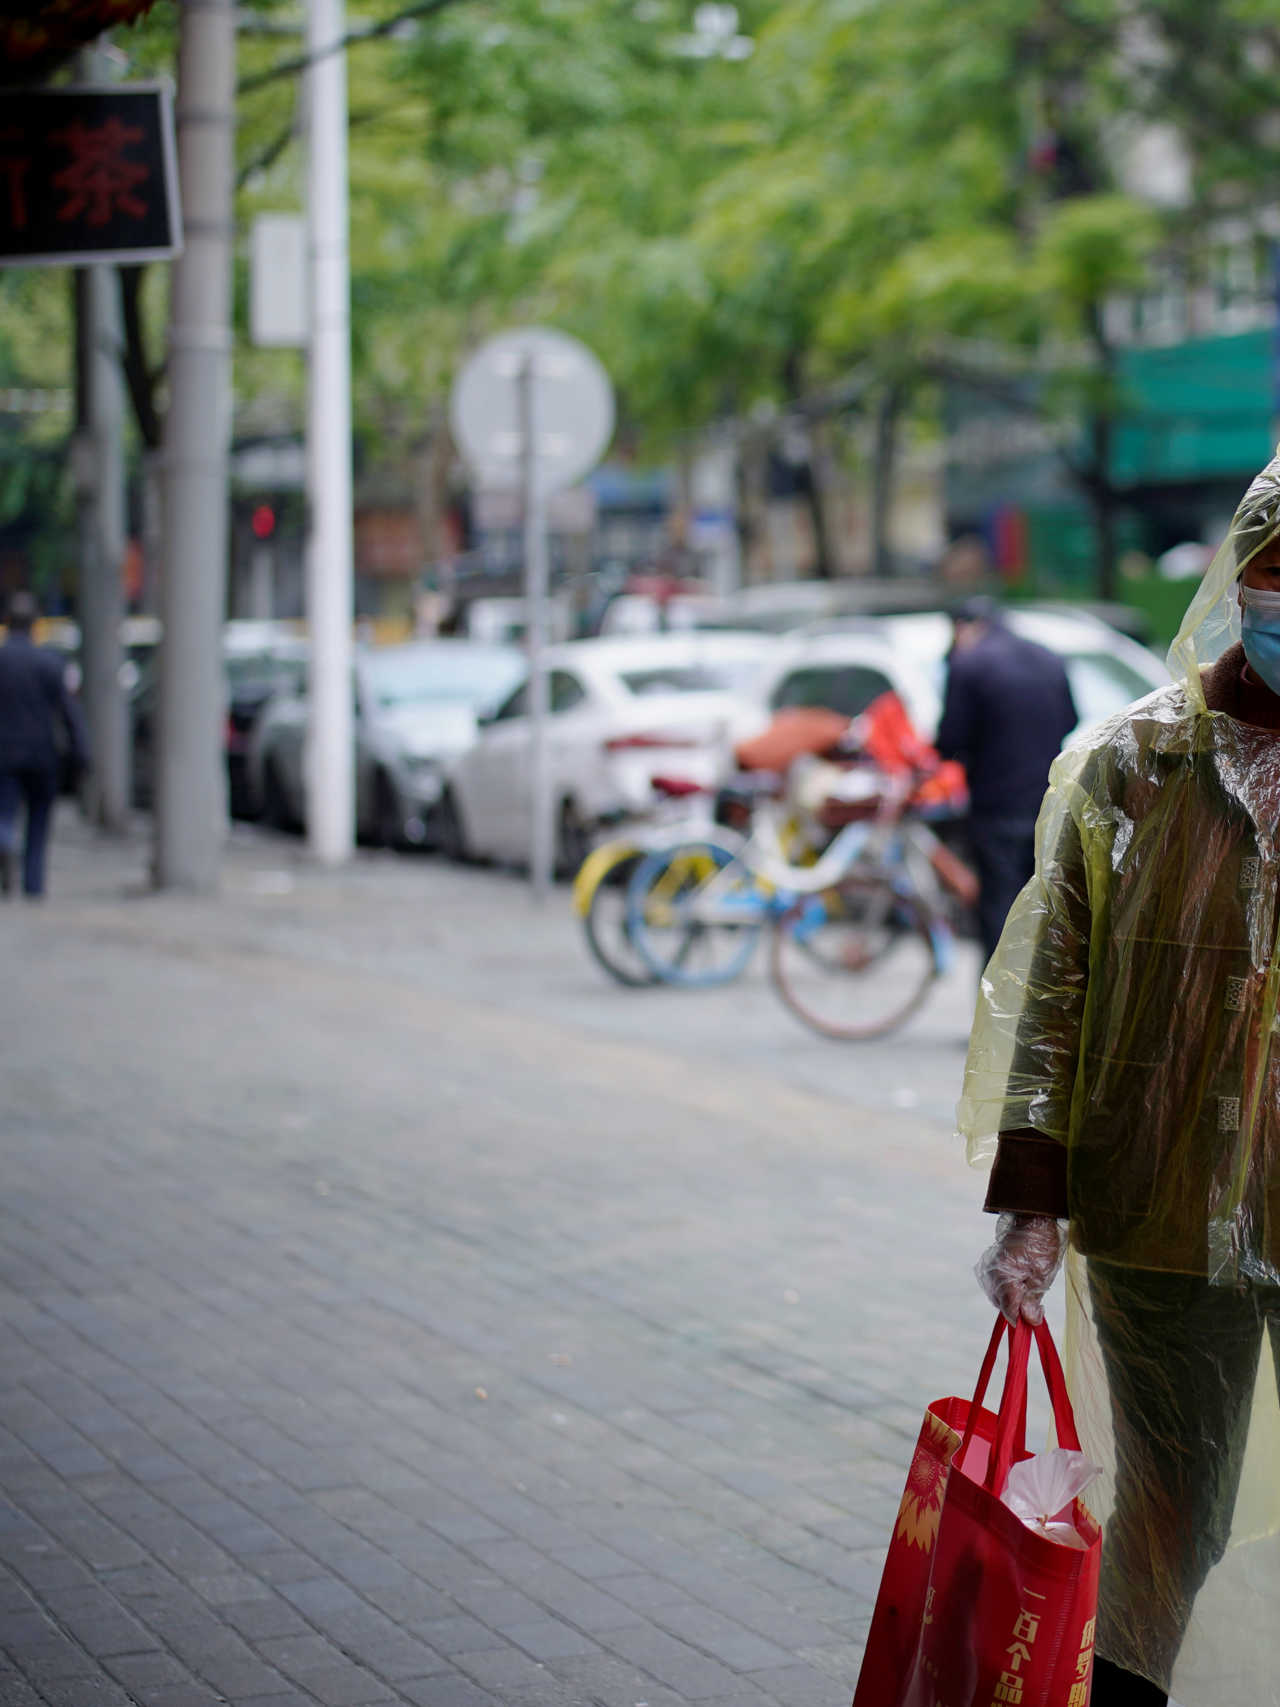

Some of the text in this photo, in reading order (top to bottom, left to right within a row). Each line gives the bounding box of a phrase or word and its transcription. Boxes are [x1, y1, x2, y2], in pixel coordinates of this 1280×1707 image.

[0, 114, 149, 229] 茶
[990, 1586, 1046, 1707] 一百个品
